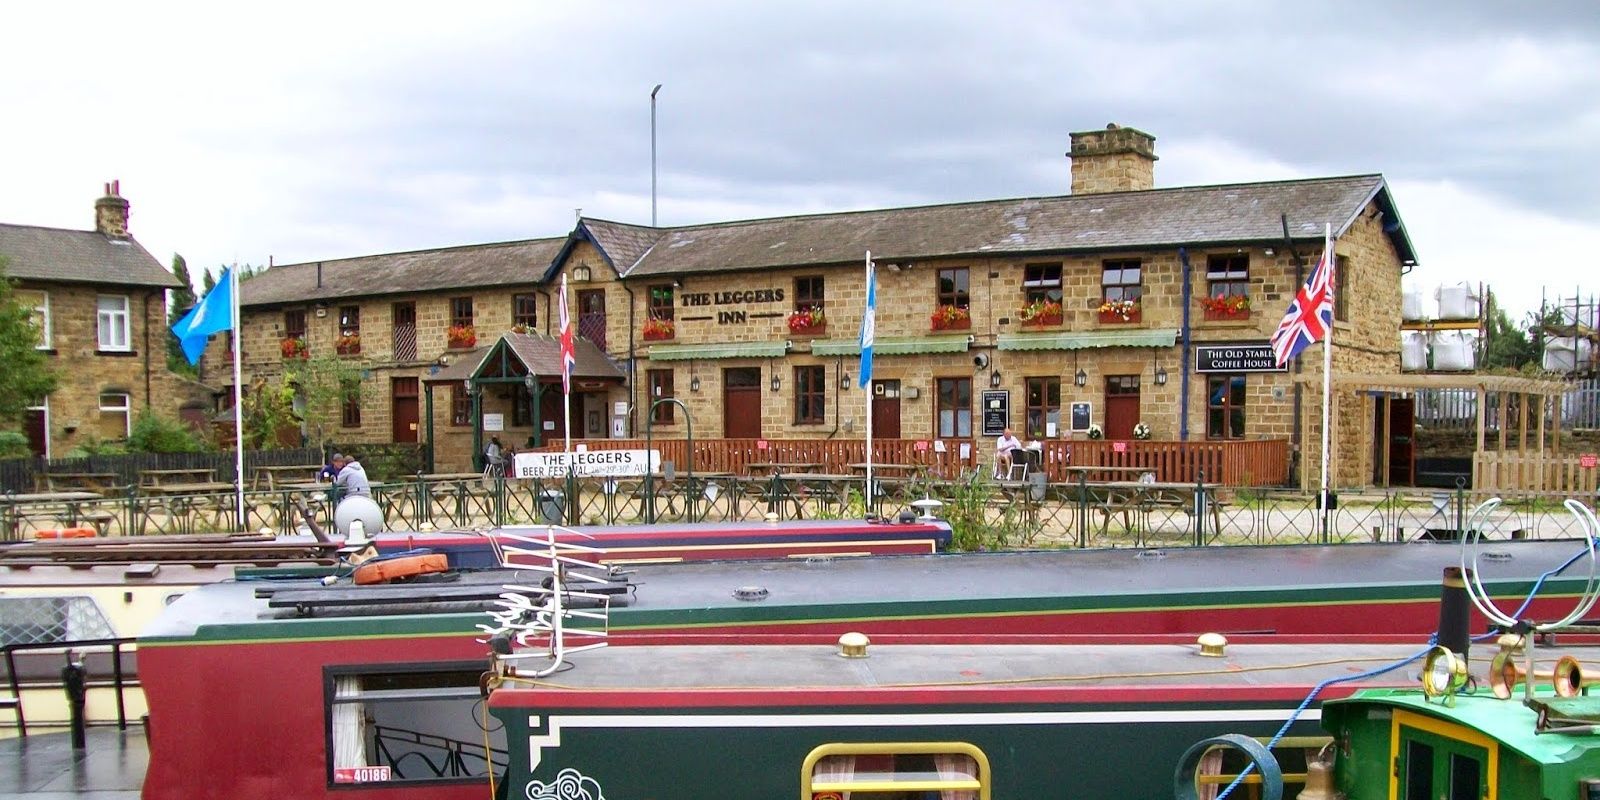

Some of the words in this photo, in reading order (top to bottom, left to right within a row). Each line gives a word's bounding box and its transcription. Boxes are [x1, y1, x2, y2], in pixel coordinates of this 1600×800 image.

[681, 293, 711, 306] THE
[714, 288, 784, 304] LEGGERS
[718, 311, 747, 324] INN
[1207, 350, 1223, 358] THE
[1225, 350, 1243, 358] OLD
[1211, 360, 1241, 368] COFFEE
[542, 455, 565, 465] THE
[571, 452, 632, 464] LEGGERS
[522, 466, 544, 476] BEER
[354, 769, 387, 782] 40186
